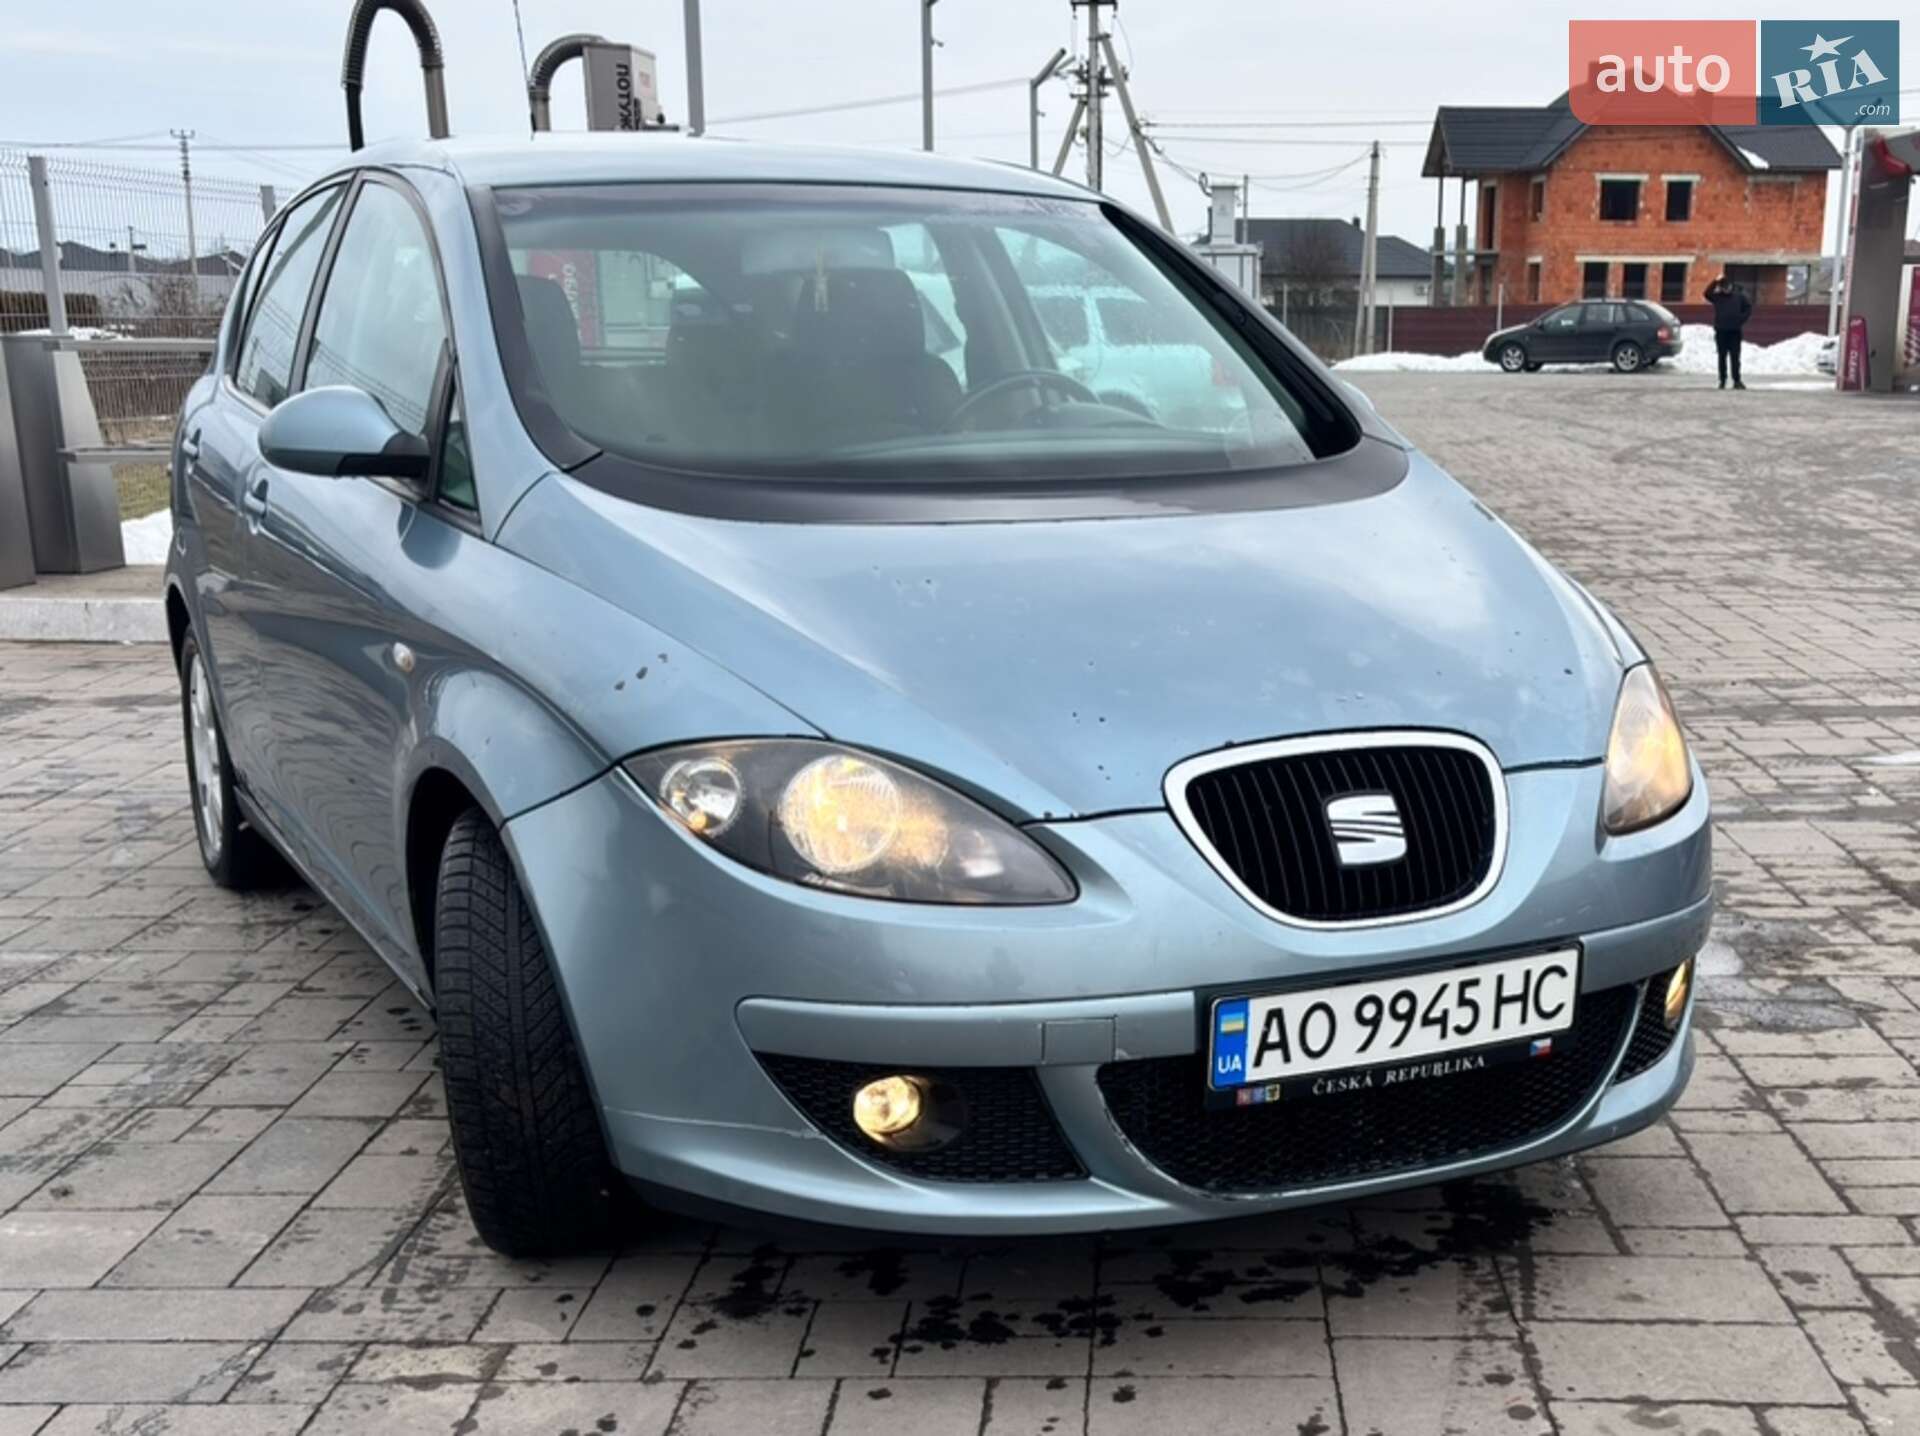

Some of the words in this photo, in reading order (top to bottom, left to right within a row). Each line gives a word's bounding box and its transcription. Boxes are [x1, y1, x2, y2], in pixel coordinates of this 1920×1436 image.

[1252, 1000, 1337, 1068] AO
[1354, 977, 1481, 1054] 9945
[1492, 964, 1569, 1030] HC
[1217, 1056, 1243, 1075] UA
[1311, 1070, 1374, 1096] ČESKÁ
[1383, 1055, 1486, 1086] REPUBLIKA
